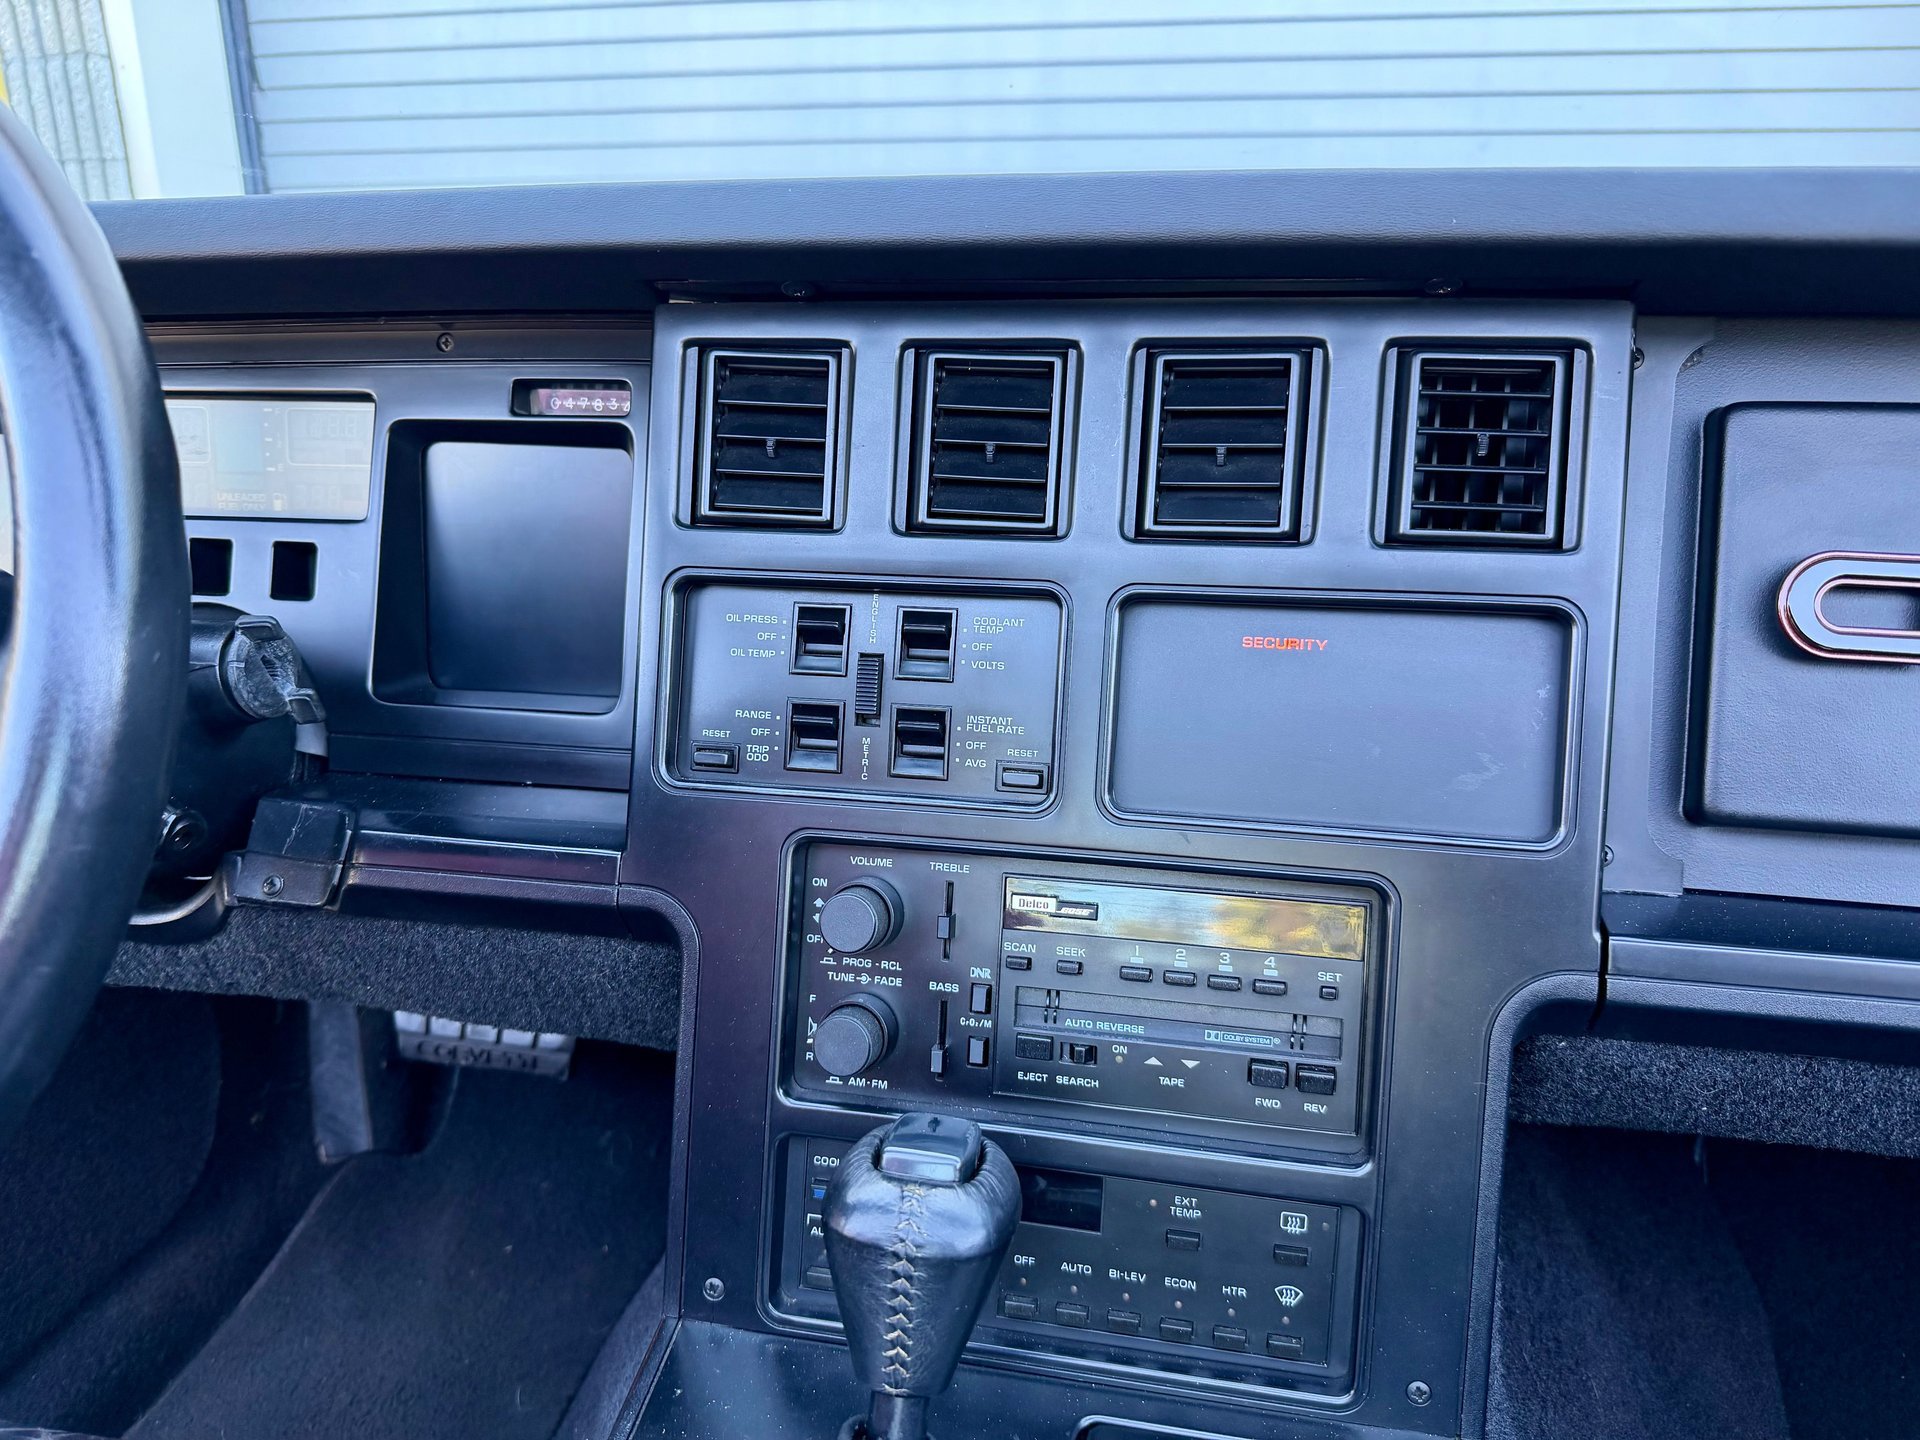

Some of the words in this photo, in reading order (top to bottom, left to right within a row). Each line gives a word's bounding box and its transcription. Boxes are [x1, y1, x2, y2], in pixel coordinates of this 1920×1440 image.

[726, 613, 741, 622] OIL
[743, 614, 778, 624] PRESS
[973, 616, 1025, 627] COOLANT
[973, 625, 1004, 635] TEMP
[757, 632, 777, 641] OFF
[971, 642, 993, 651] OFF
[1241, 636, 1328, 651] SECURITY
[730, 648, 745, 657] OIL
[747, 648, 776, 658] TEMP
[971, 660, 1005, 670] VOLTS
[735, 709, 772, 720] RANGE
[966, 715, 1013, 726] INSTANT
[702, 729, 731, 738] RESET
[751, 727, 771, 736] OFF
[966, 724, 994, 733] FUEL
[996, 725, 1025, 735] RATE
[746, 744, 770, 753] TRIP
[965, 740, 987, 750] OFF
[746, 753, 769, 762] ODO
[861, 737, 871, 781] METRIC
[1007, 748, 1039, 758] RESET
[964, 758, 987, 768] AVG
[850, 856, 893, 868] VOLUME
[929, 861, 970, 874] TREBLE
[812, 877, 828, 888] ON
[1018, 898, 1049, 910] Delco
[1003, 941, 1036, 953] SCAN
[1056, 945, 1086, 958] SEEK
[1133, 945, 1141, 957] 1
[1175, 949, 1187, 960] 2
[1219, 952, 1230, 964] 3
[842, 957, 872, 968] PROG
[1264, 956, 1276, 968] 4
[827, 971, 855, 982] TUNE
[874, 975, 903, 987] FADE
[970, 966, 992, 980] DNR
[1317, 970, 1343, 983] SET
[929, 981, 960, 993] BASS
[809, 994, 817, 1003] F
[1064, 1018, 1093, 1029] AUTO
[1096, 1021, 1145, 1035] REVERSE
[1223, 1033, 1244, 1043] DOLBY
[1244, 1035, 1271, 1045] SYSTEM
[1112, 1044, 1128, 1054] ON
[805, 1051, 814, 1061] R
[1017, 1071, 1048, 1083] EJECT
[1055, 1075, 1099, 1089] SEARCH
[1158, 1076, 1185, 1088] TAPE
[1254, 1097, 1281, 1110] FWD
[1303, 1101, 1328, 1114] REV
[1174, 1195, 1198, 1208] EXT
[1170, 1205, 1202, 1219] TEMP
[1013, 1254, 1036, 1267] OFF
[1060, 1261, 1092, 1275] AUTO
[1108, 1268, 1146, 1284] BI-LEV
[1164, 1276, 1197, 1291] ECON
[1221, 1285, 1247, 1299] HTR
